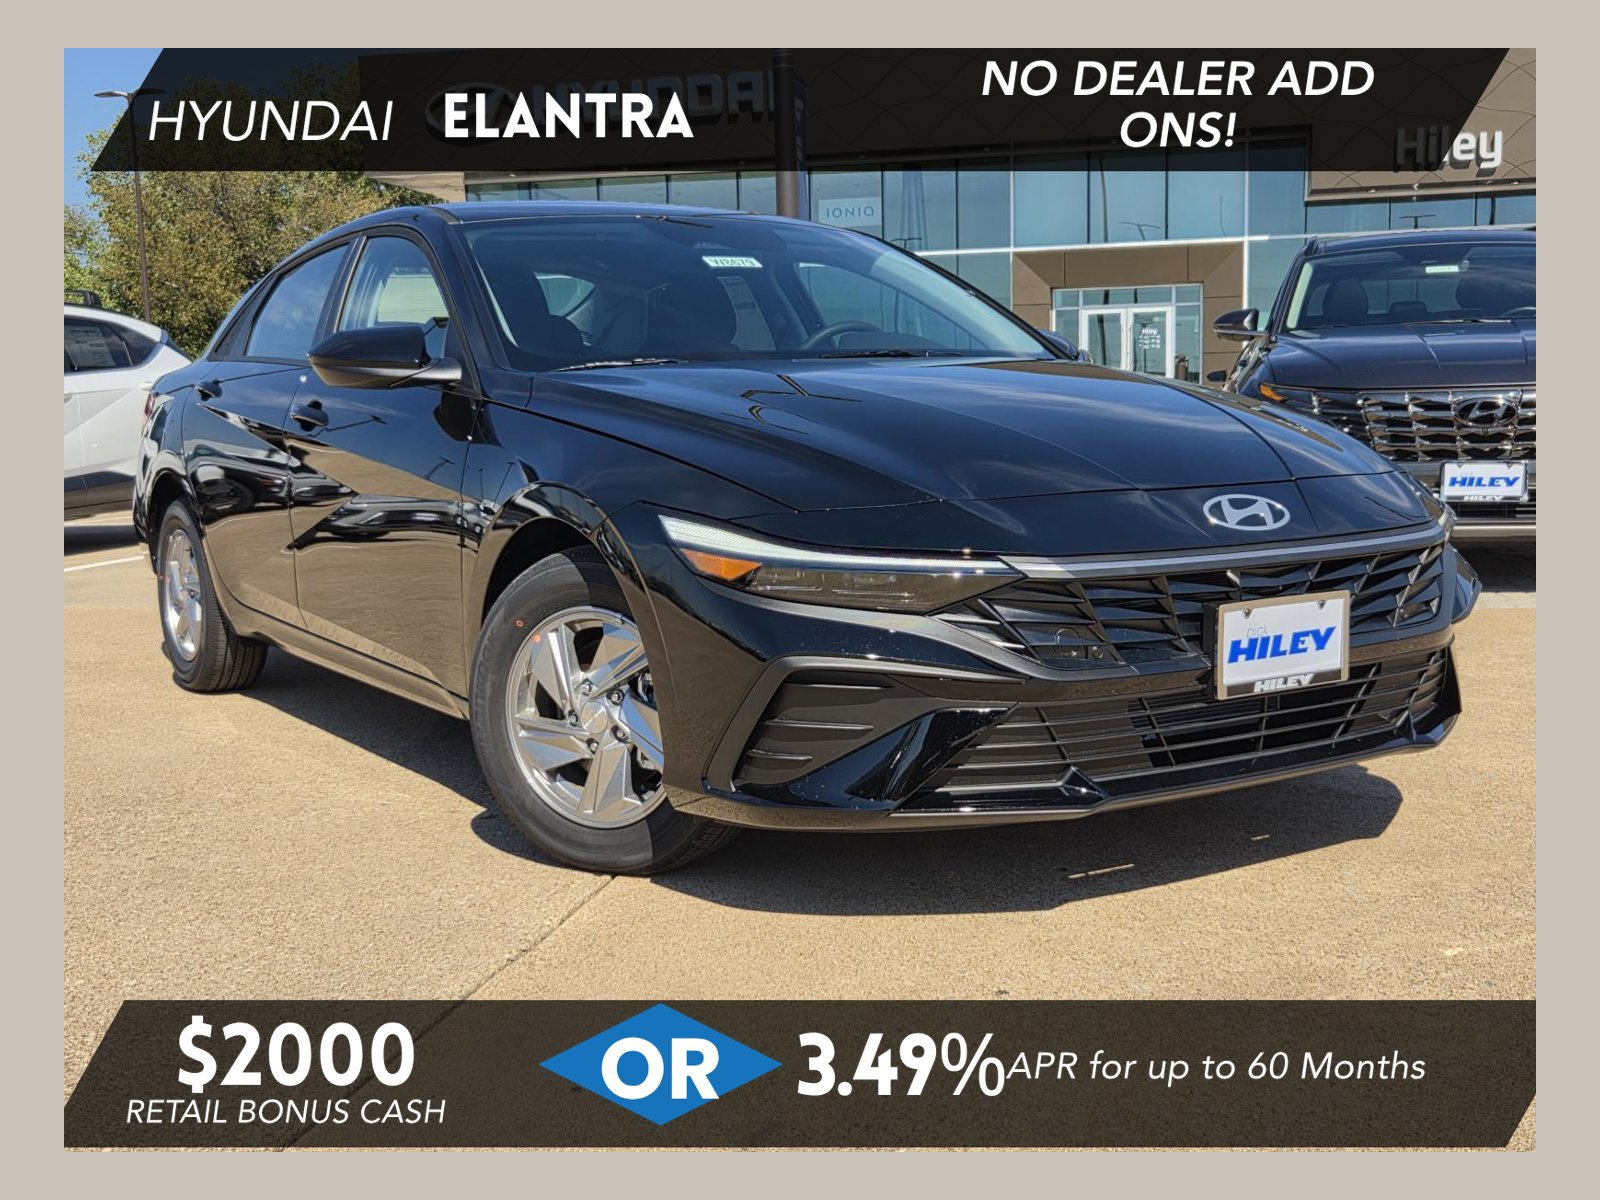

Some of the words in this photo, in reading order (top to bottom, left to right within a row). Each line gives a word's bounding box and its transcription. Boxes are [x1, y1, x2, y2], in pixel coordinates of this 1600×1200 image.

[826, 206, 874, 218] IONIQ
[1448, 476, 1520, 487] HILEY
[1228, 626, 1336, 664] HILEY
[1254, 674, 1314, 693] HILEY
